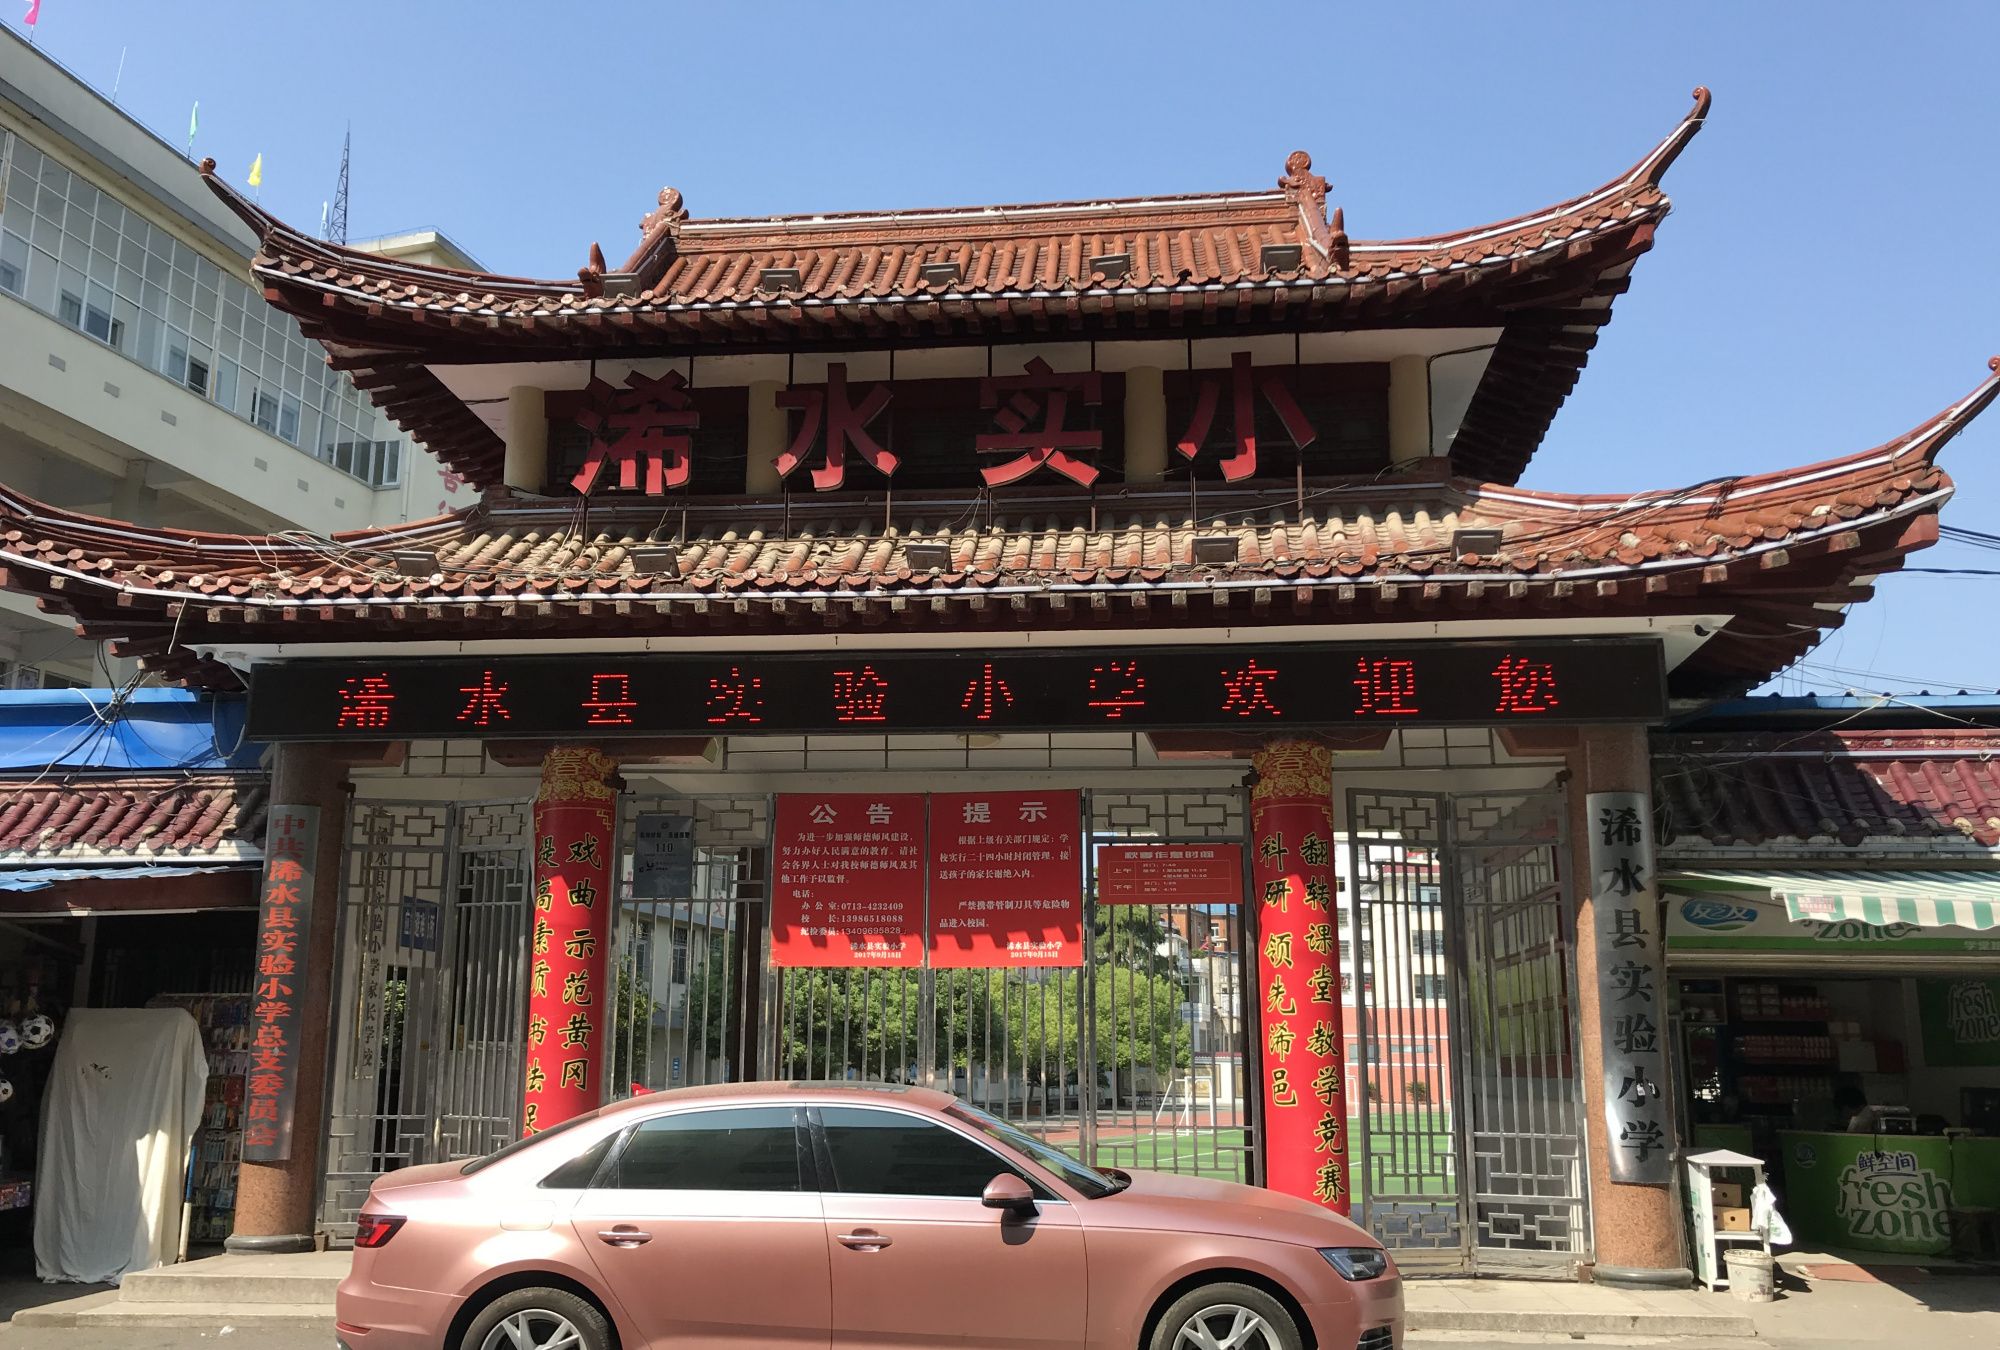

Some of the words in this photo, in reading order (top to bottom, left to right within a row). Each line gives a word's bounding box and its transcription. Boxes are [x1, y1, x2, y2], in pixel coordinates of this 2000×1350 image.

[570, 351, 1316, 497] 浠水实小
[336, 654, 1560, 727] 浠水县实验小学欢迎您
[809, 803, 893, 824] 公告
[963, 801, 1047, 824] 提示
[656, 843, 673, 853] 110
[781, 860, 918, 870] 会各界人士对我校师德师风及其
[958, 899, 1070, 911] 严禁携带管制刀具等危险物
[246, 814, 305, 1146] 中共浠水县实验小学总支委员会
[557, 832, 602, 1091] 戏曲示范黄冈
[1260, 832, 1298, 1107] 科研领先浠邑
[1600, 808, 1664, 1162] 浠水县实验小学
[1299, 832, 1345, 1204] 翻转课堂教学竞赛
[1858, 1151, 1917, 1173] 鲜空间
[1838, 1167, 1951, 1213] fresh
[1850, 1207, 1952, 1238] zone
